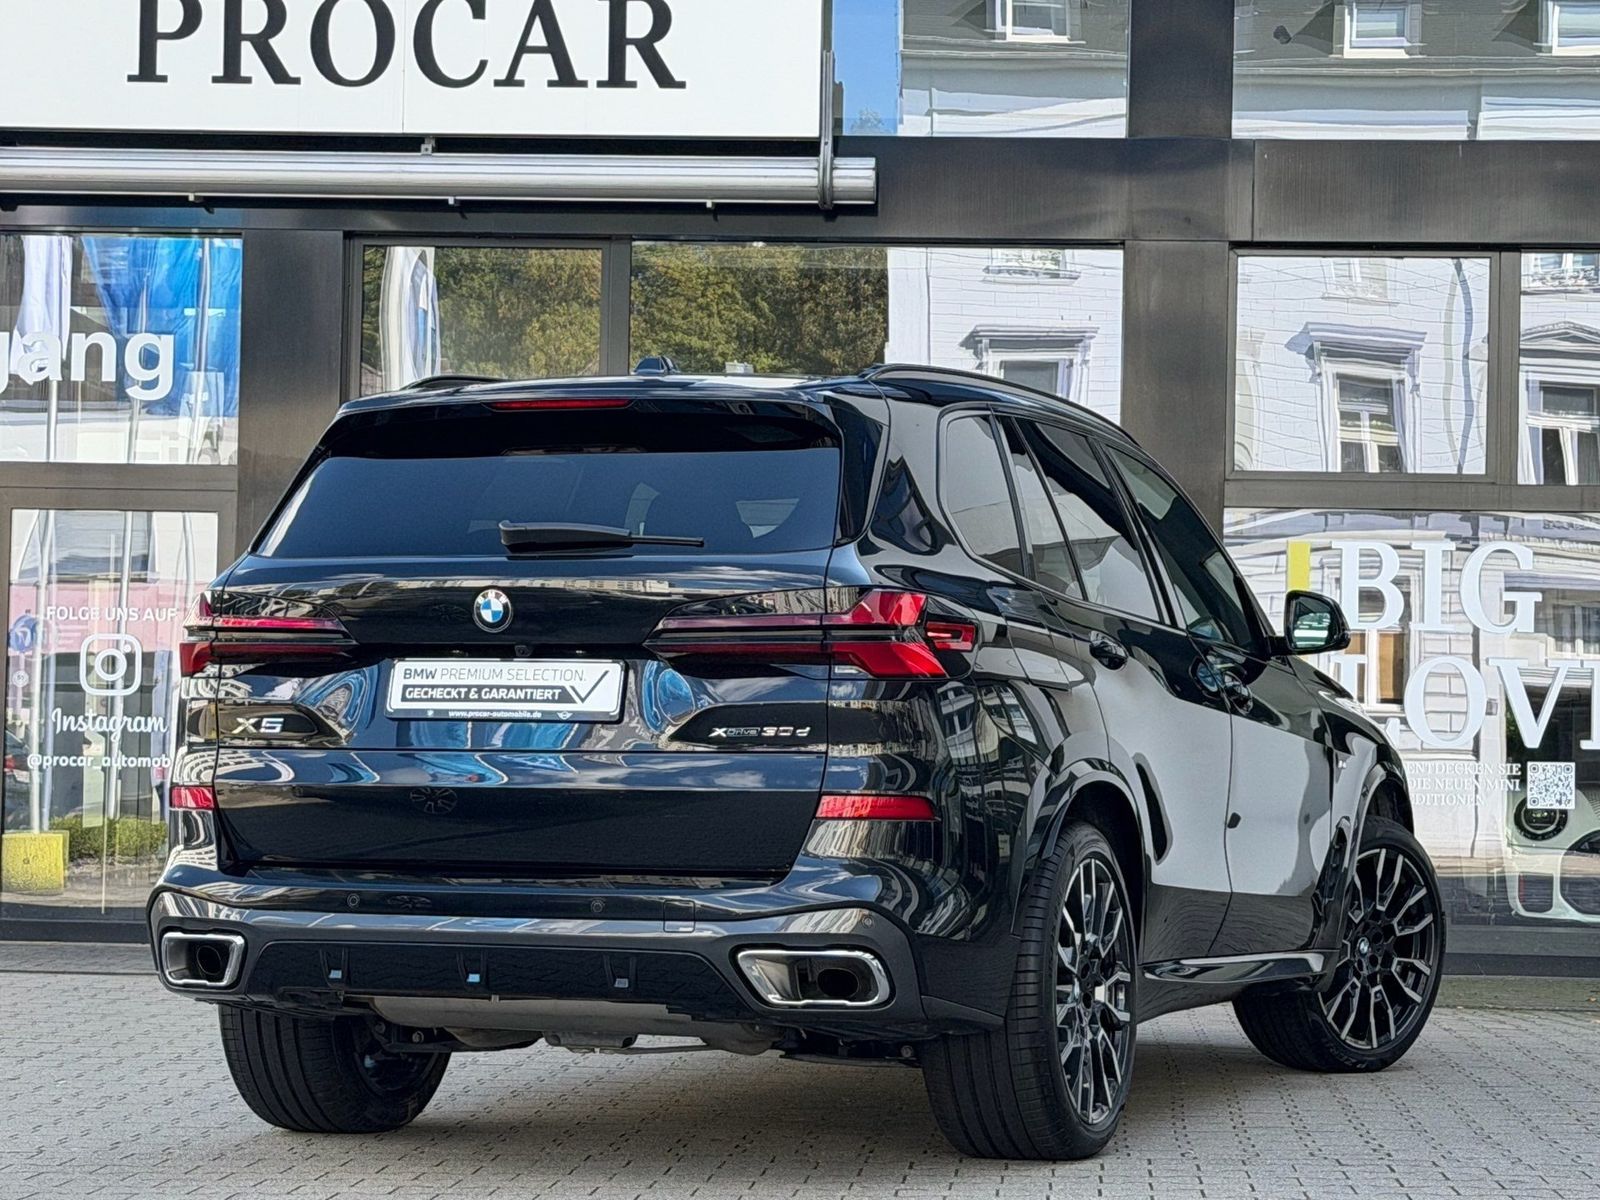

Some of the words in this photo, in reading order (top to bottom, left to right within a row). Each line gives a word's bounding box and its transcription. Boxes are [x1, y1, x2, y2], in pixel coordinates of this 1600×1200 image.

[126, 0, 687, 88] PROCAR
[0, 332, 175, 400] ang
[1332, 540, 1543, 634] BIG
[46, 606, 100, 621] FOLGE
[105, 606, 139, 622] UNS
[143, 607, 178, 622] AUF
[403, 668, 438, 681] BMW
[440, 668, 503, 681] PREMIUM
[405, 687, 468, 700] GECHECKT
[469, 688, 479, 700] &
[481, 688, 562, 701] GARANTIERT
[1331, 655, 1600, 750] LOV
[448, 710, 542, 719] www.procar-automobile.de
[51, 707, 169, 742] Instagram
[231, 717, 285, 734] X5
[1407, 762, 1493, 775] ENTDECKEN
[1498, 763, 1521, 776] SIE
[1435, 778, 1481, 791] NEUEN
[1486, 778, 1521, 792] MINI
